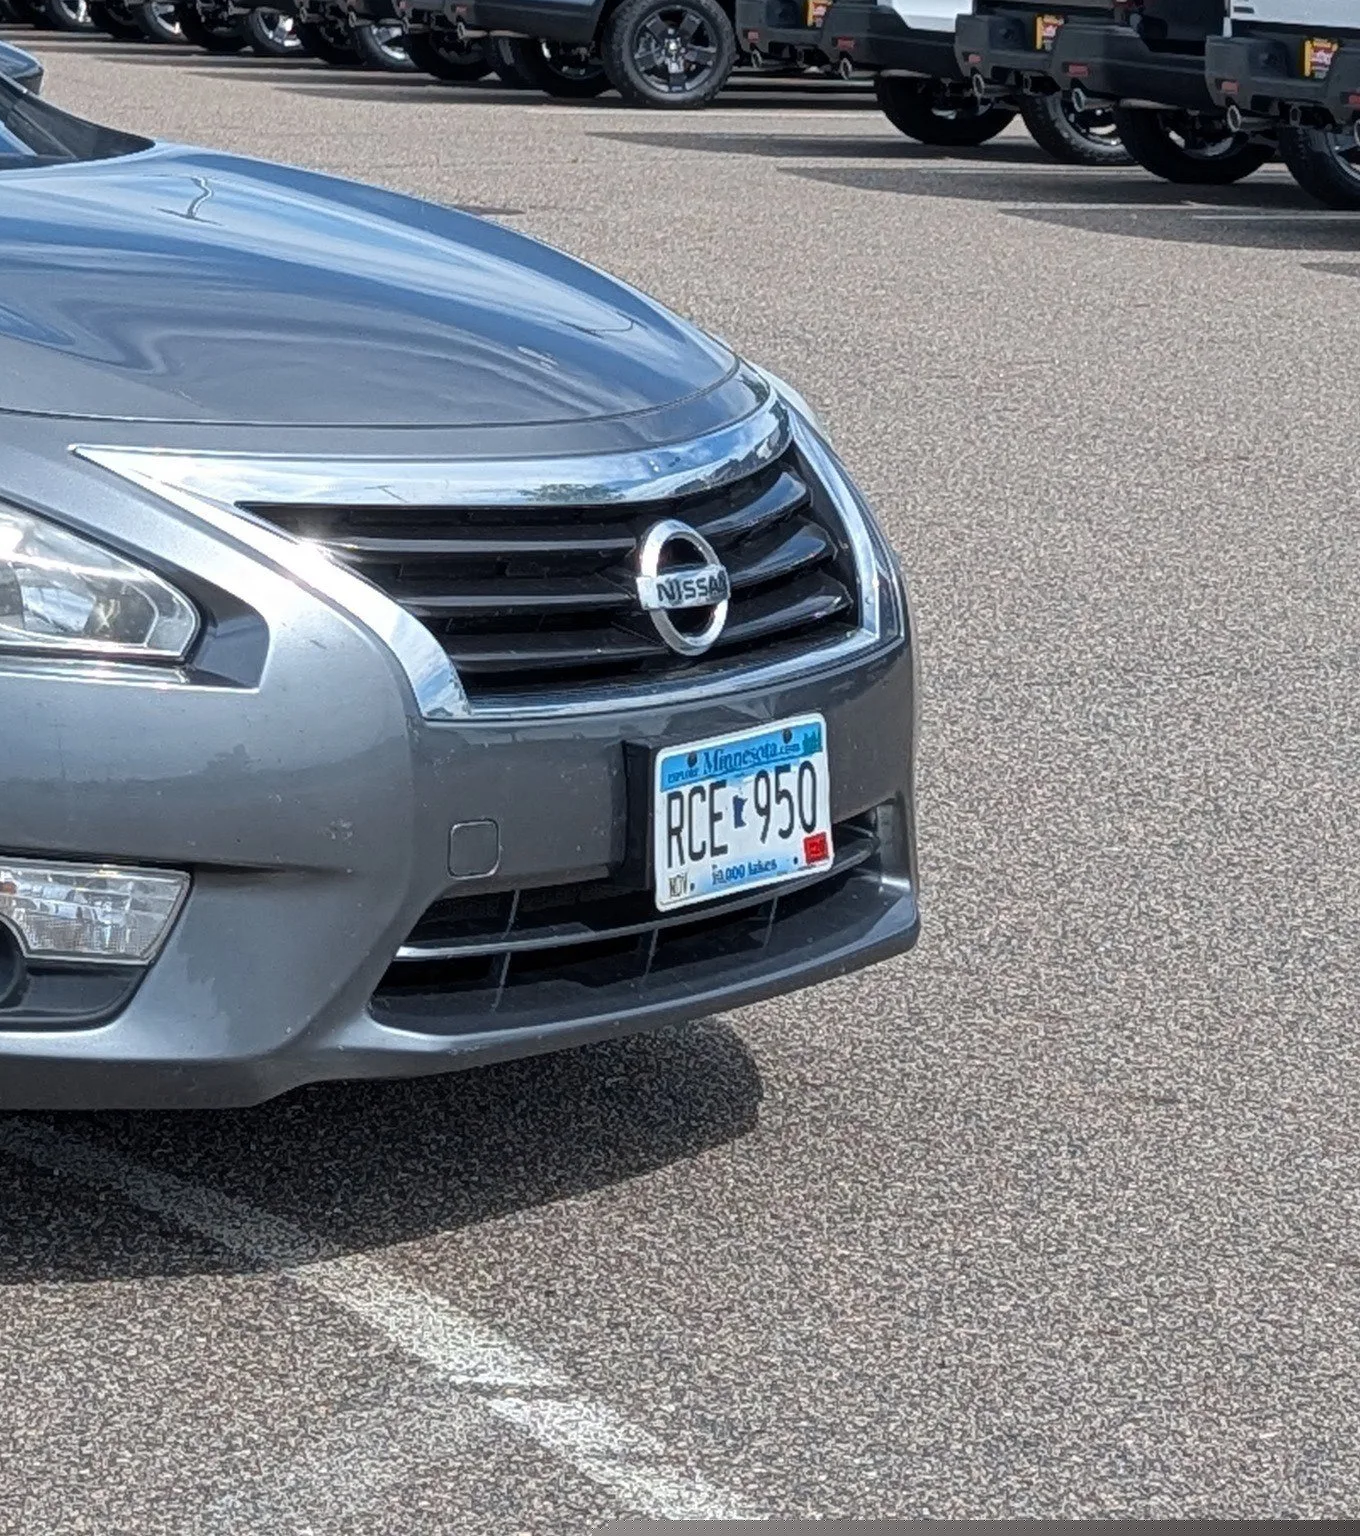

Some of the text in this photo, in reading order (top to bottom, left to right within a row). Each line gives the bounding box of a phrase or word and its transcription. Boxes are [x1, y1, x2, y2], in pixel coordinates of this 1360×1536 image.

[656, 570, 727, 605] NISSAN
[703, 742, 778, 775] Minnesota
[667, 760, 817, 868] RCE 950
